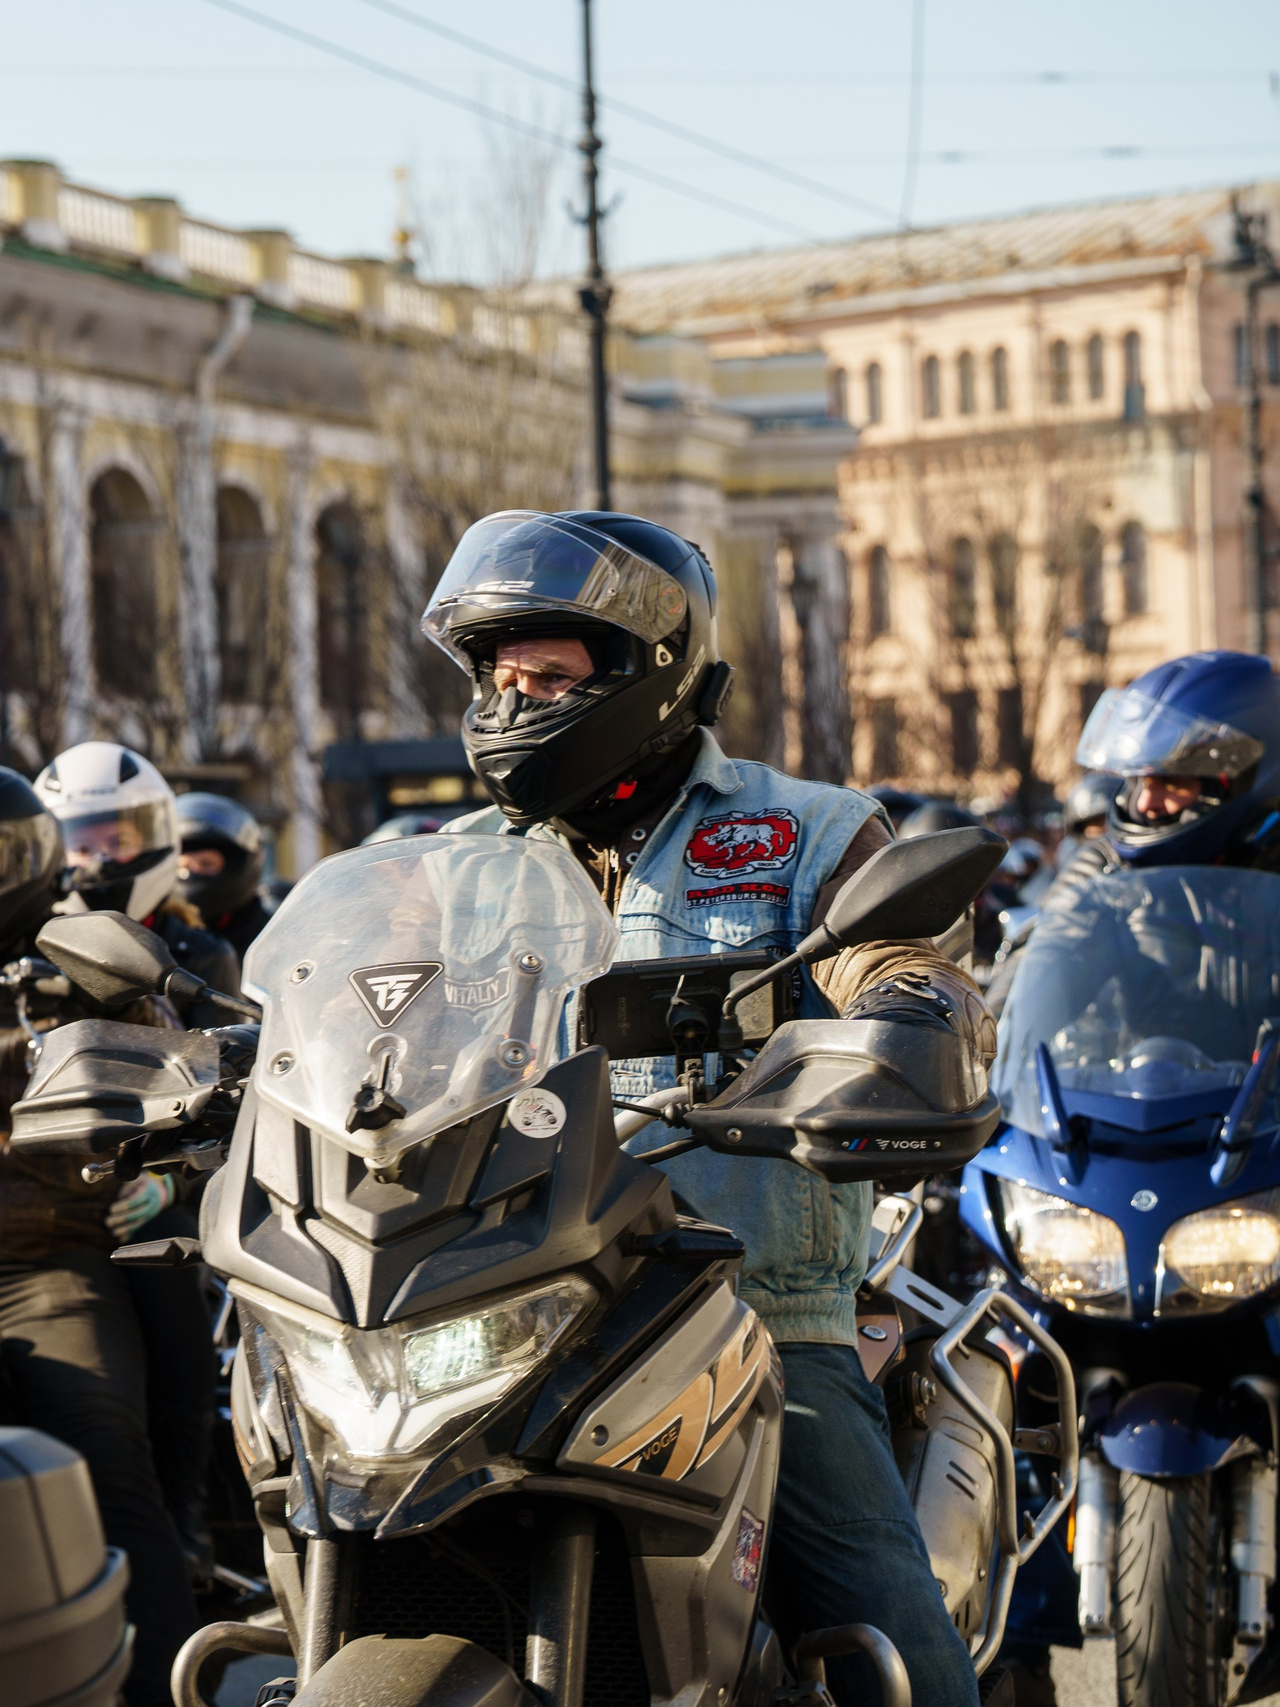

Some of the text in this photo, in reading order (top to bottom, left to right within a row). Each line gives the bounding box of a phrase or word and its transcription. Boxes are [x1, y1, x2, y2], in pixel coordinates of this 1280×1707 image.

[658, 643, 707, 722] LS2
[687, 885, 735, 899] RED
[444, 980, 500, 1004] VITALIY
[891, 1140, 927, 1149] VOGE
[642, 1426, 678, 1461] VOGE
